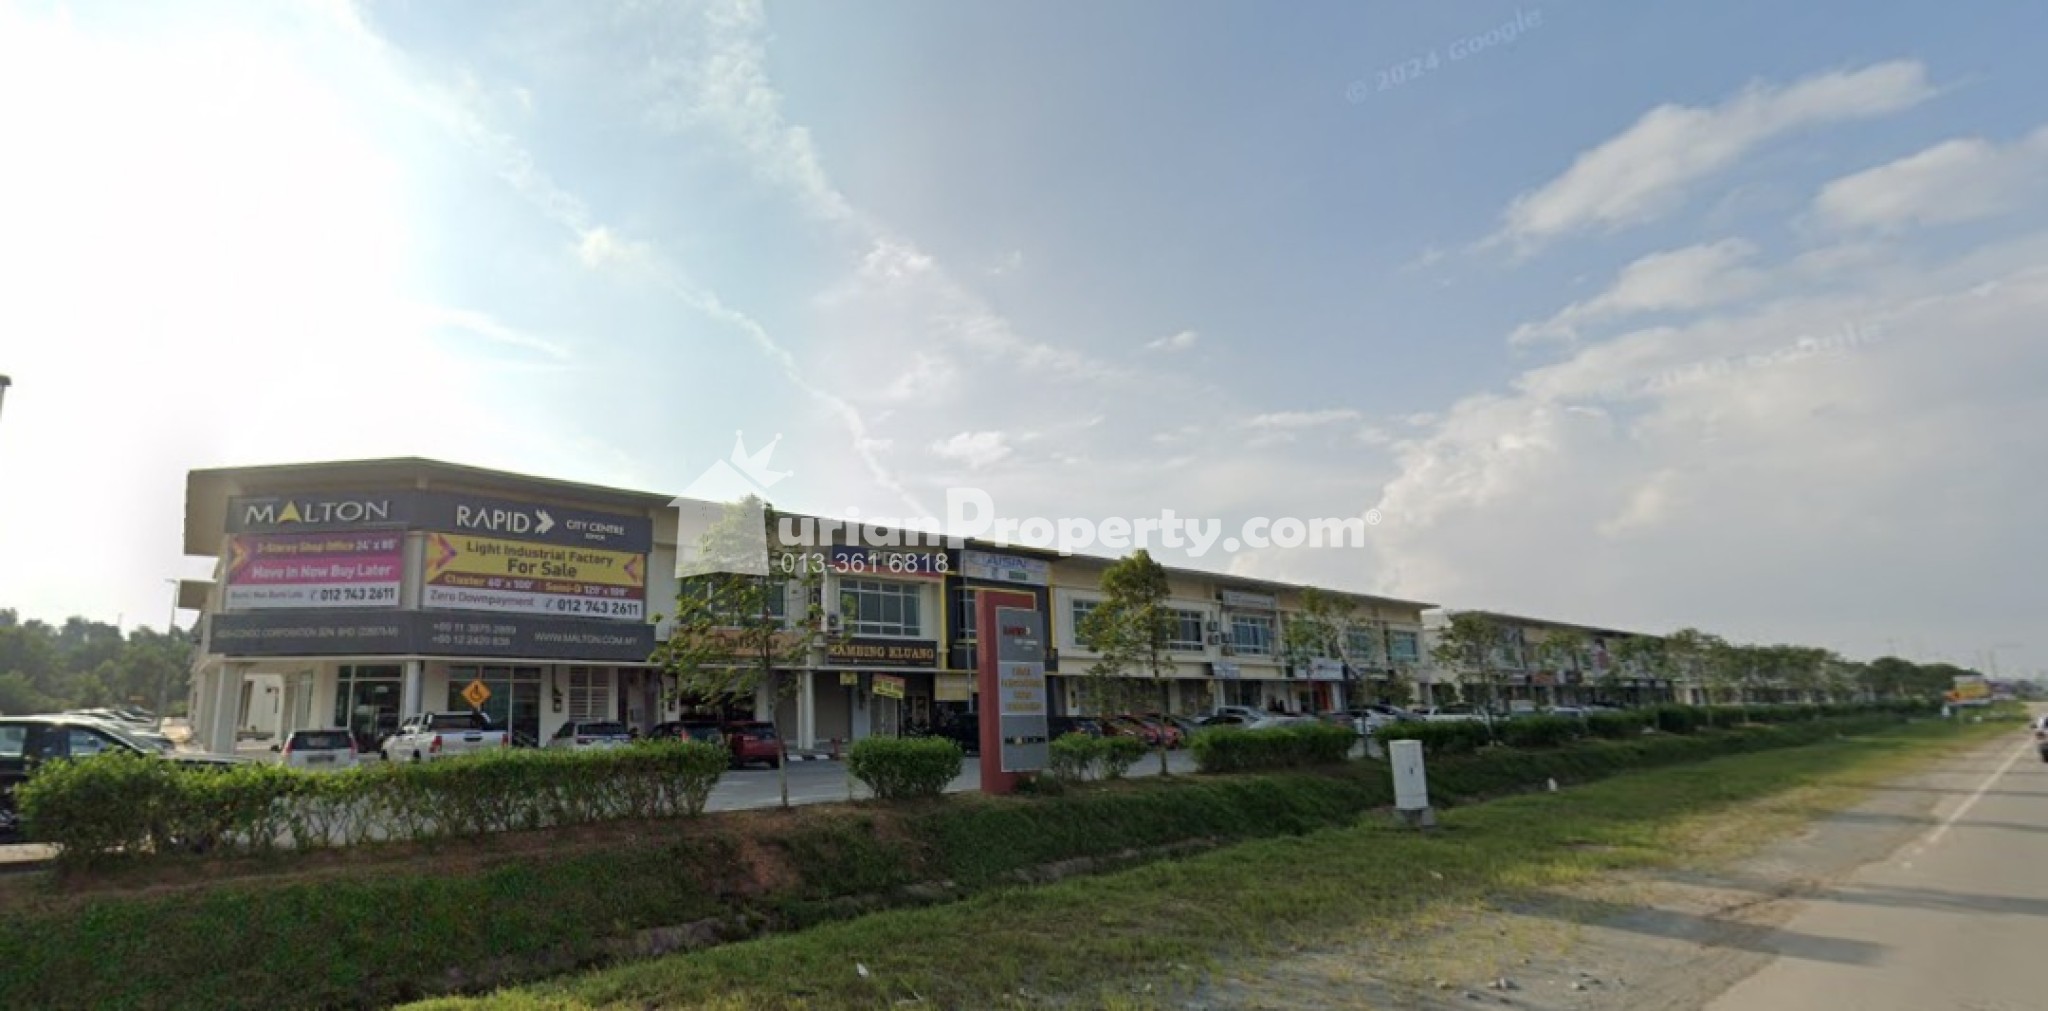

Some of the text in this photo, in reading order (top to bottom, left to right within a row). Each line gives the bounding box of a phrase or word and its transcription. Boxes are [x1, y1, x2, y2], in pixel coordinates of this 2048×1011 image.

[244, 499, 389, 525] MALTON
[456, 504, 530, 534] RAPID
[566, 518, 625, 536] CITY CENTRE
[300, 541, 323, 553] Shop
[325, 540, 354, 552] Office
[466, 541, 614, 567] Light Industrial Factory
[252, 566, 284, 579] Move
[301, 564, 329, 578] Now
[331, 564, 355, 579] Buy
[358, 563, 393, 577] Later
[507, 558, 577, 578] For Sale
[320, 587, 395, 601] 012 743 2611
[430, 590, 535, 607] Zero Downpayment
[557, 599, 639, 616] 012 743 2611
